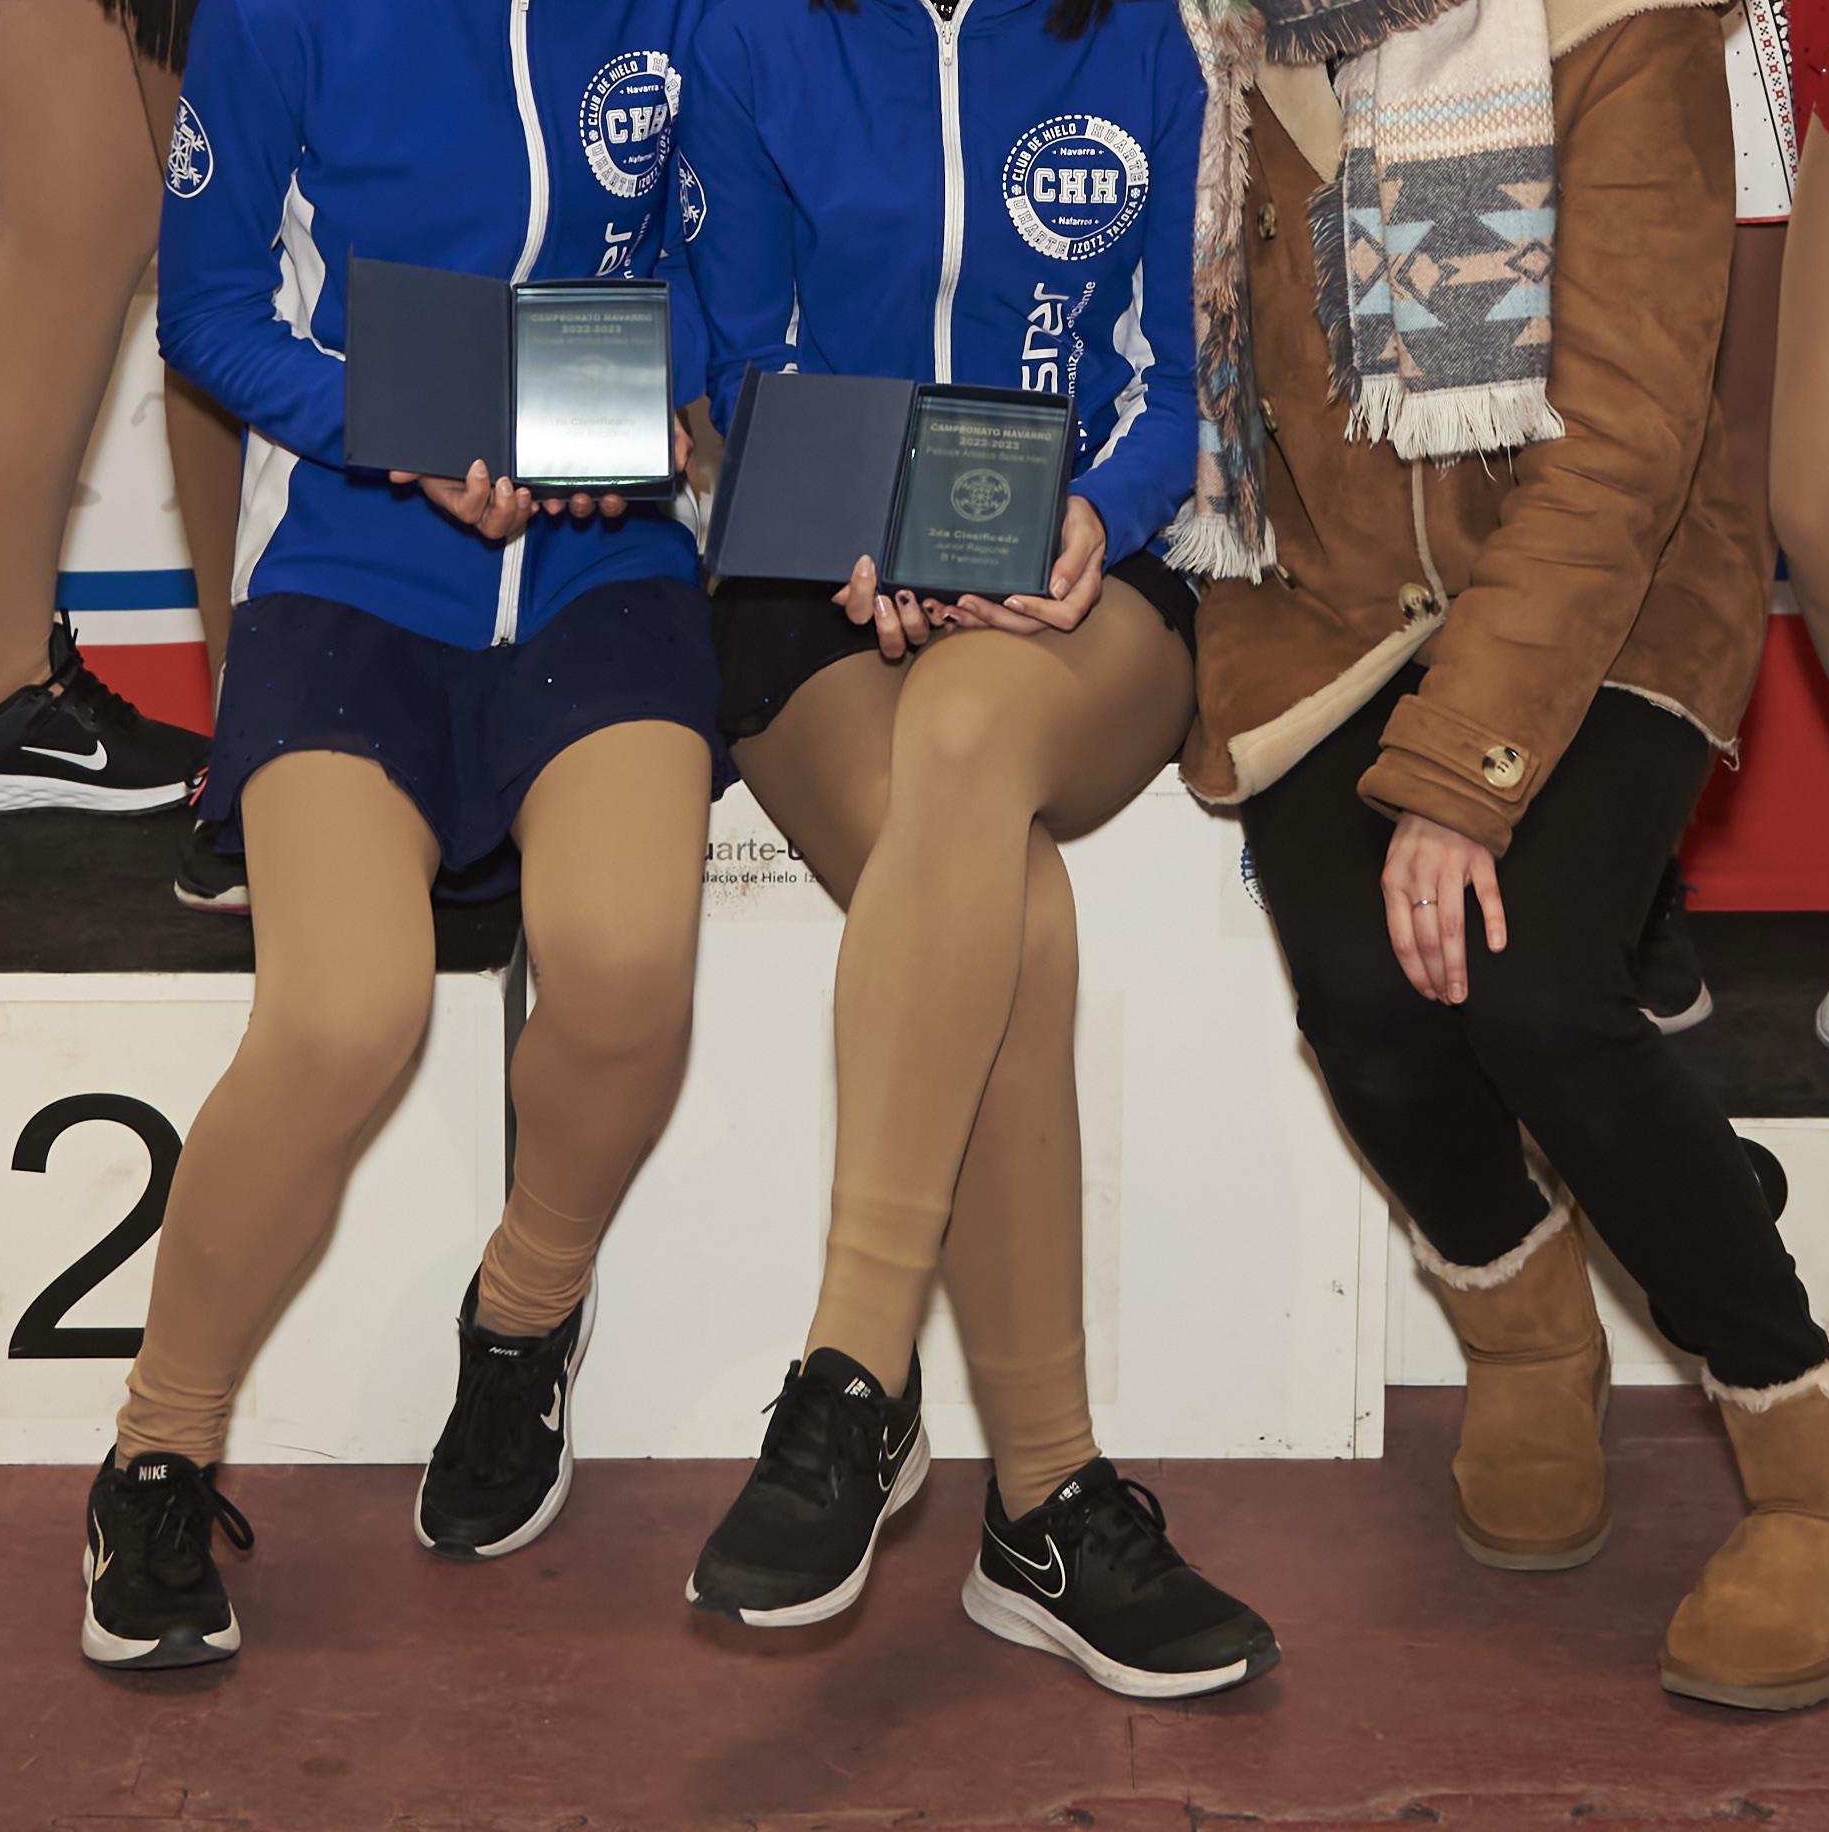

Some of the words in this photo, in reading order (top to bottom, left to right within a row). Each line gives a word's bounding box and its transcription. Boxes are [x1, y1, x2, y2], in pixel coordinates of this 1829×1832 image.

[588, 96, 601, 126] CLUB
[597, 78, 611, 94] DE
[609, 61, 638, 81] HIELO
[626, 84, 659, 94] Navarra
[1012, 151, 1031, 182] CLUB
[1027, 137, 1042, 151] DE
[1042, 123, 1076, 141] HIELO
[1091, 124, 1144, 182] HUARTE
[1060, 148, 1096, 156] Navarra
[1033, 168, 1119, 204] CHH
[1014, 199, 1067, 254] UHARTE
[1073, 235, 1104, 254] IZOTZ
[1107, 202, 1138, 237] TALDEA
[742, 872, 757, 883] de
[762, 872, 797, 883] Hielo
[8, 1092, 184, 1360] 2
[139, 1465, 168, 1480] NIKE
